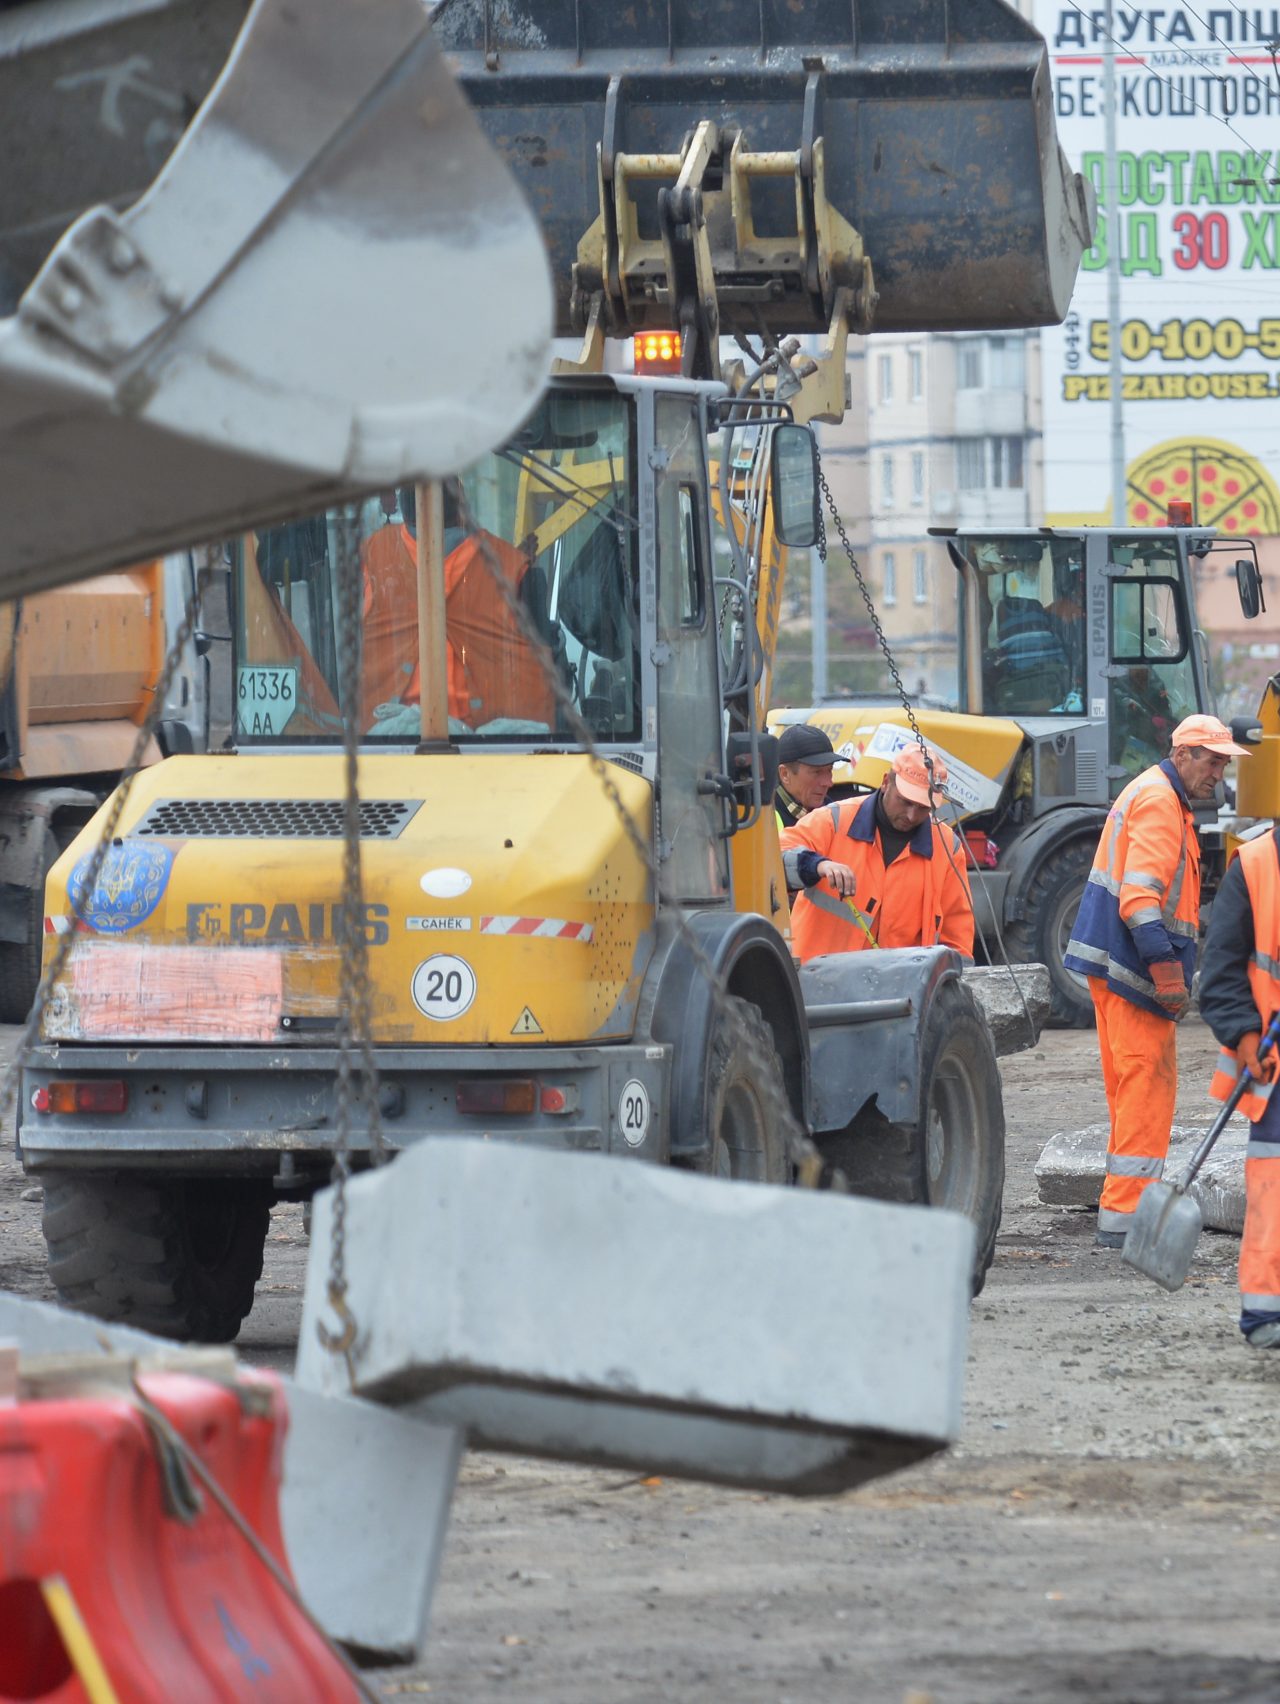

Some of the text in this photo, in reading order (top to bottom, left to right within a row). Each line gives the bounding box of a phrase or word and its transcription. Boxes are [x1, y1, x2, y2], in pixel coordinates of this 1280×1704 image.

[1054, 9, 1196, 48] ДРУГА
[1081, 211, 1163, 277] ВД
[1172, 211, 1230, 271] 30
[238, 671, 292, 701] 61336
[252, 711, 273, 734] AA
[421, 917, 463, 929] САНЁК
[426, 970, 463, 1002] 20
[626, 1096, 643, 1129] 20
